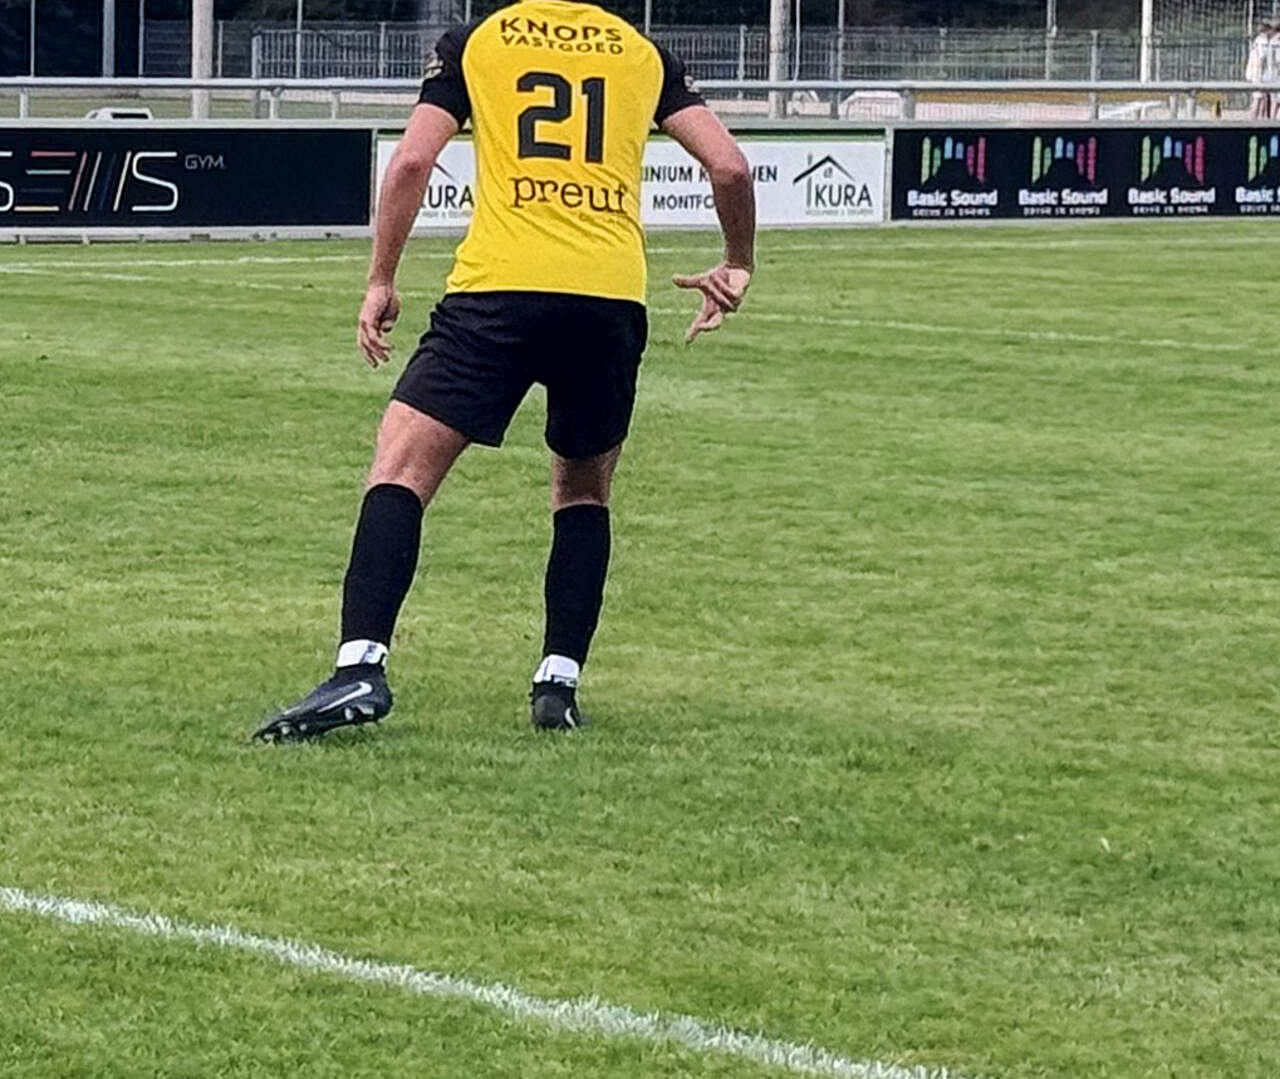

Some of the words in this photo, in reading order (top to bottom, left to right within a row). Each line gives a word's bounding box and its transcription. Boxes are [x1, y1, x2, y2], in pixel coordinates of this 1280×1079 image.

[500, 17, 623, 42] KNOPS
[500, 34, 624, 55] VASTGOED
[516, 71, 606, 164] 21
[641, 166, 693, 182] INIUM
[420, 185, 474, 209] URA
[652, 195, 715, 210] MONTFO
[907, 190, 948, 206] Basic
[950, 190, 998, 206] Sound
[1019, 189, 1059, 205] Basic
[1061, 188, 1108, 205] Sound
[1128, 188, 1168, 204] Basic
[1170, 187, 1216, 204] Sound
[1235, 187, 1275, 203] Basic
